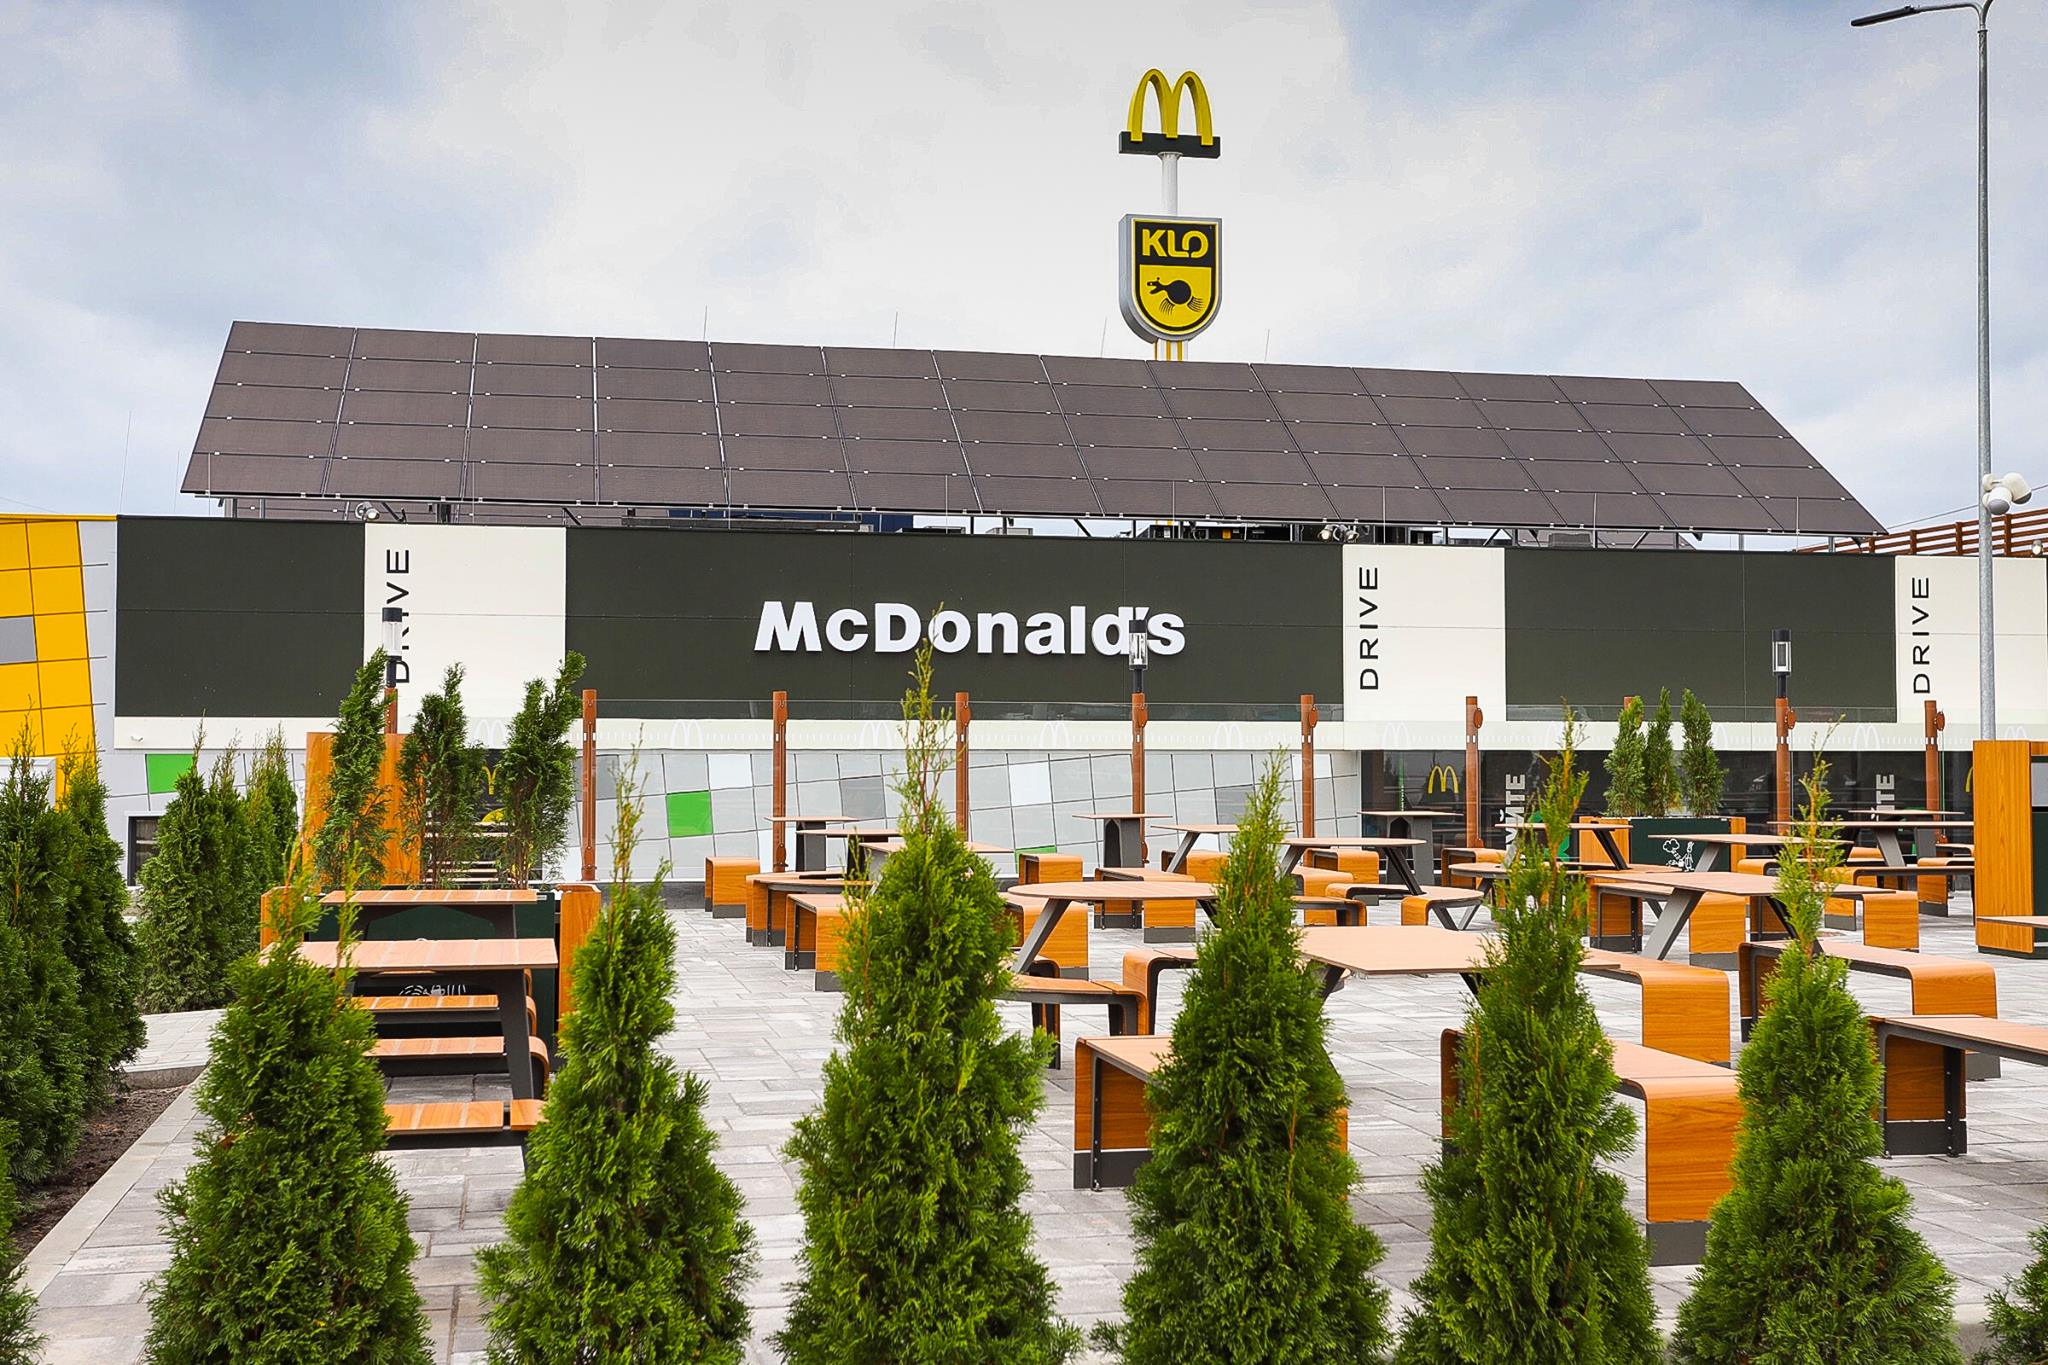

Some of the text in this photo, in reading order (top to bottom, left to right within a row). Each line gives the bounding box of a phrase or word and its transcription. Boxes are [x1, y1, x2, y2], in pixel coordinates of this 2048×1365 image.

[1142, 228, 1209, 258] KLO
[753, 600, 1186, 656] McDonald's
[1359, 567, 1379, 690] DRIVE
[1911, 577, 1931, 694] DRIVE
